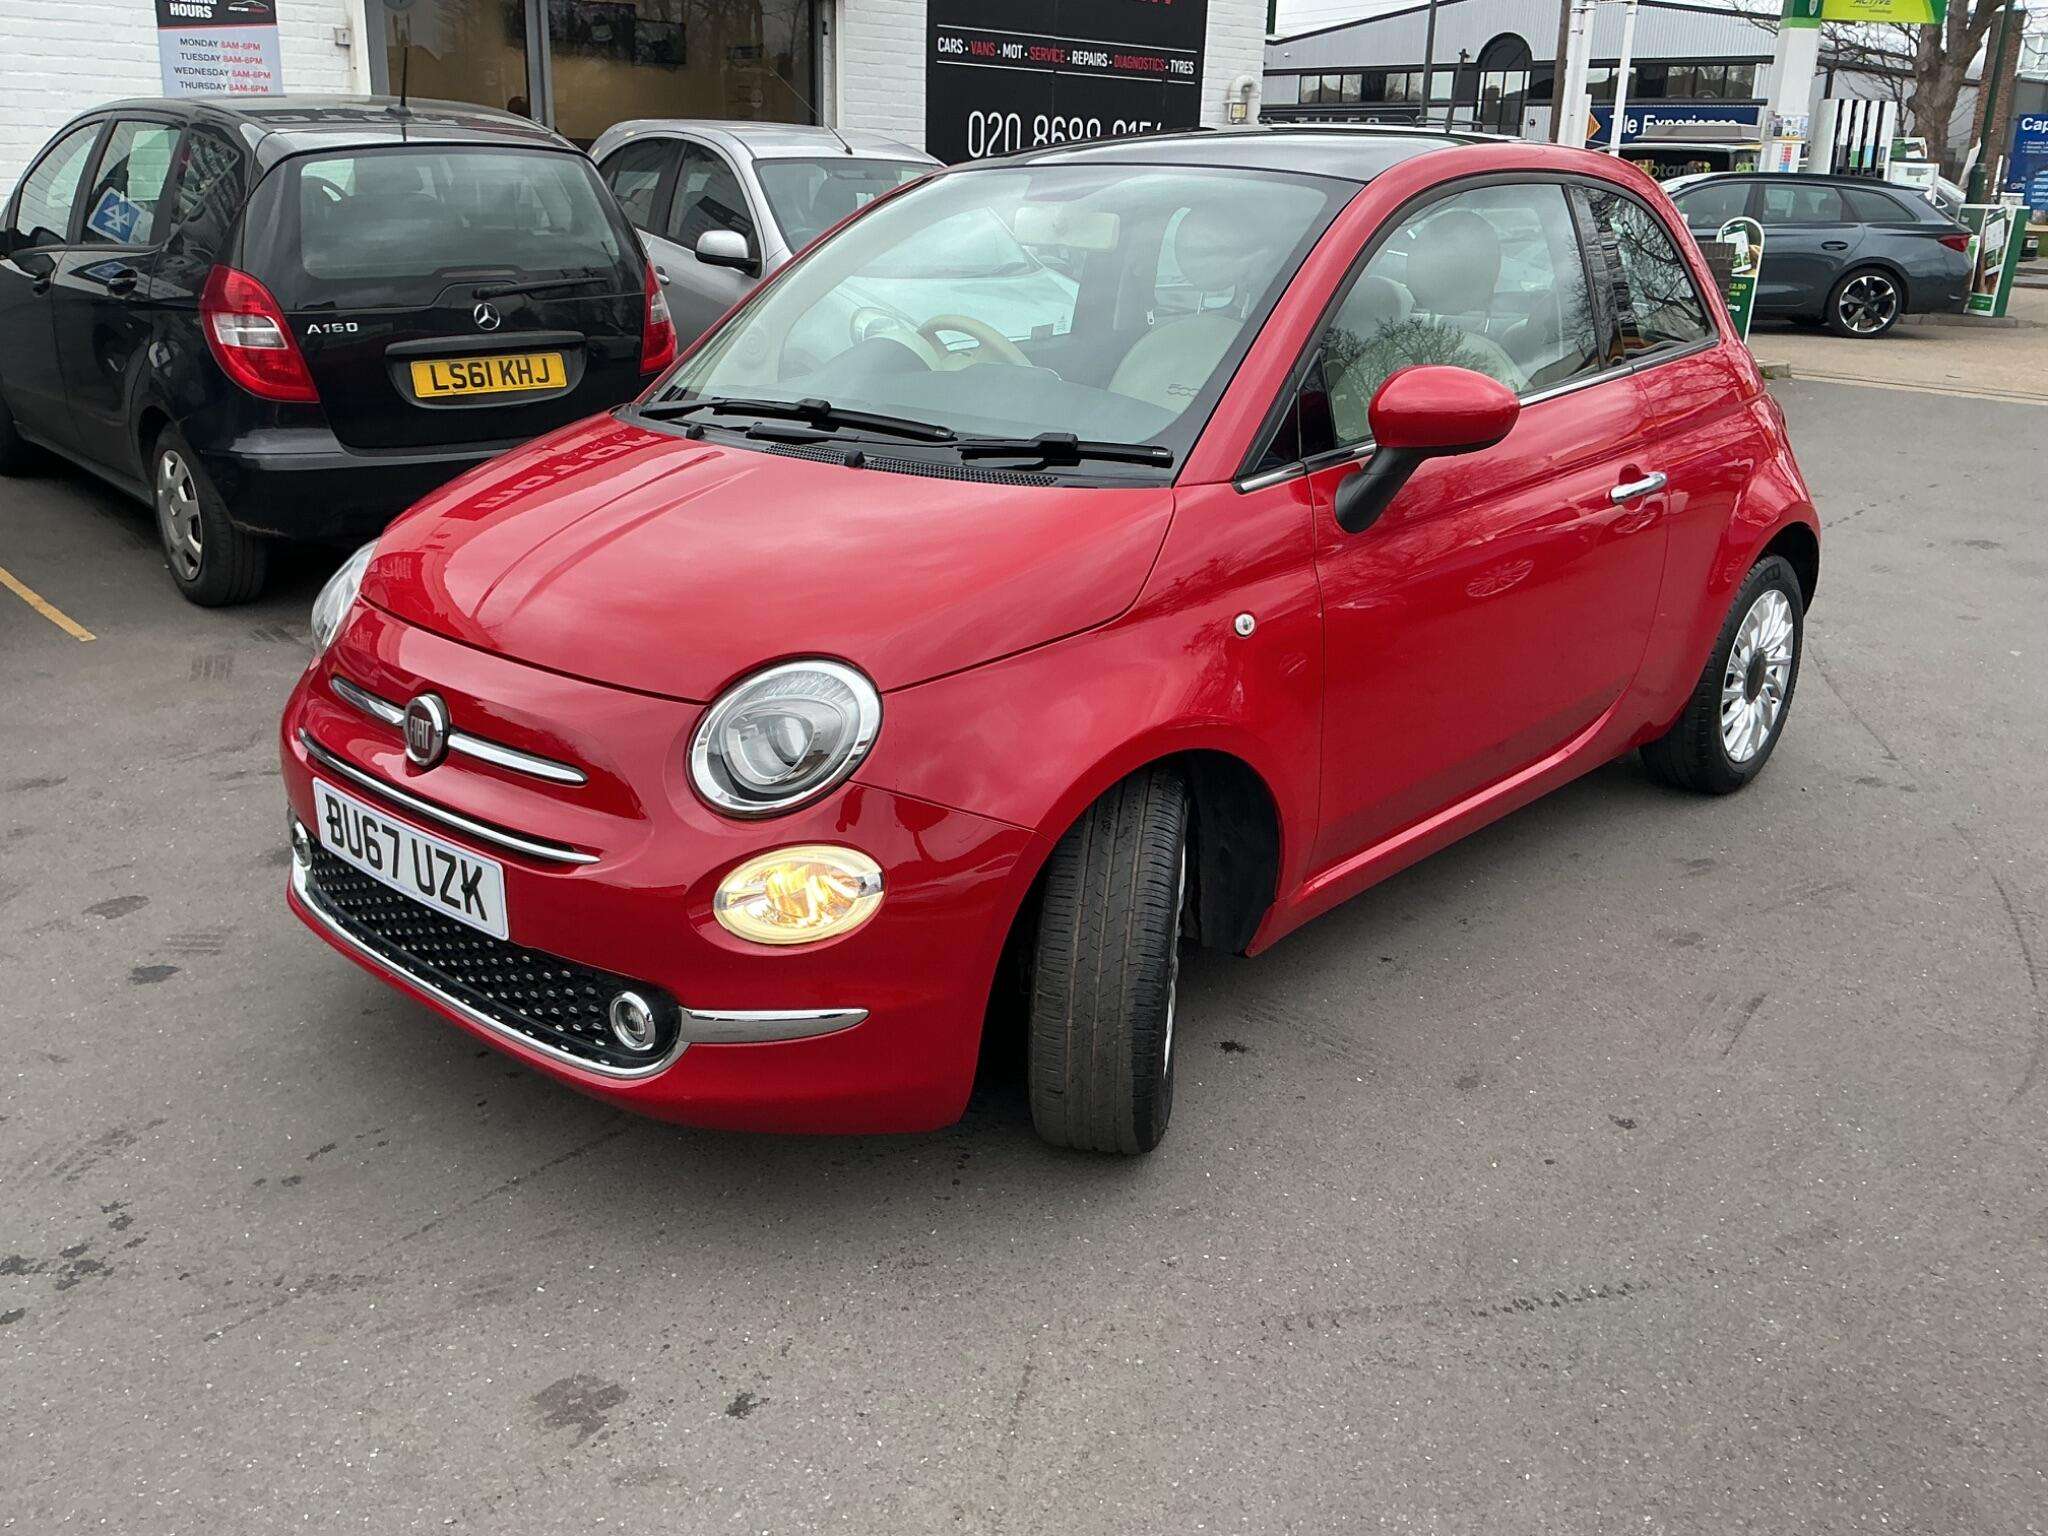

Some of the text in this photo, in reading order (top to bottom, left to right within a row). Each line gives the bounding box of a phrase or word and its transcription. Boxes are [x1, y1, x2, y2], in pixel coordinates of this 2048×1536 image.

[170, 3, 213, 19] HOURS
[179, 38, 218, 49] MONDAY
[937, 36, 1194, 75] CARS VANS MOT SERVICE REPAIRS DIAGNOSTICS TYRES
[180, 52, 221, 63] TUESDAY
[174, 66, 229, 77] WEDNESDAY
[179, 81, 227, 92] THURSDAY
[968, 110, 1022, 158] 020
[430, 357, 551, 391] LS61 KHJ
[409, 715, 432, 750] FIAT
[325, 793, 488, 921] BU67 UZK
